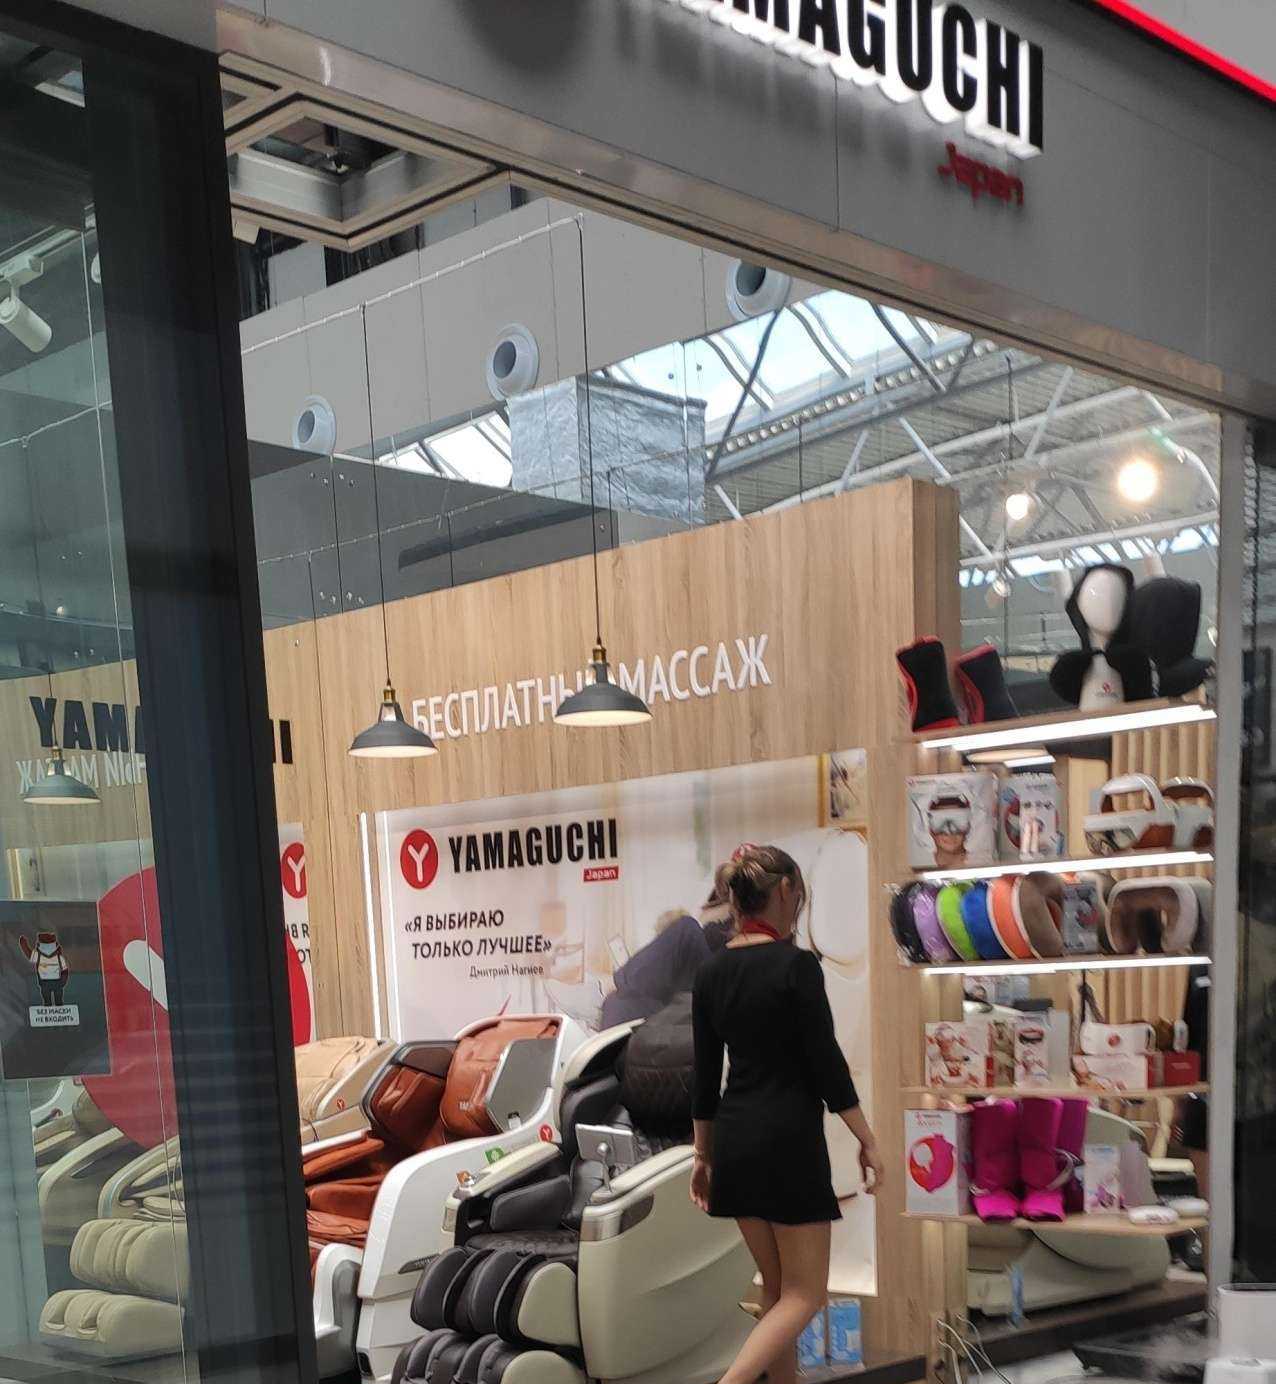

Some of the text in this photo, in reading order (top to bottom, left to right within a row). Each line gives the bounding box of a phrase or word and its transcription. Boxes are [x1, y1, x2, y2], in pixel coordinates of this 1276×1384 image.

[411, 633, 773, 741] БЕСПЛАТНЫ МАССАЖ
[448, 818, 618, 874] YAMAGUCHI
[585, 868, 617, 882] Japan
[405, 909, 505, 933] «Я ВЫБИРАЮ
[412, 934, 552, 960] ТОЛЬКО ЛУЧШЕЕ»
[469, 964, 510, 979] Дмитрий
